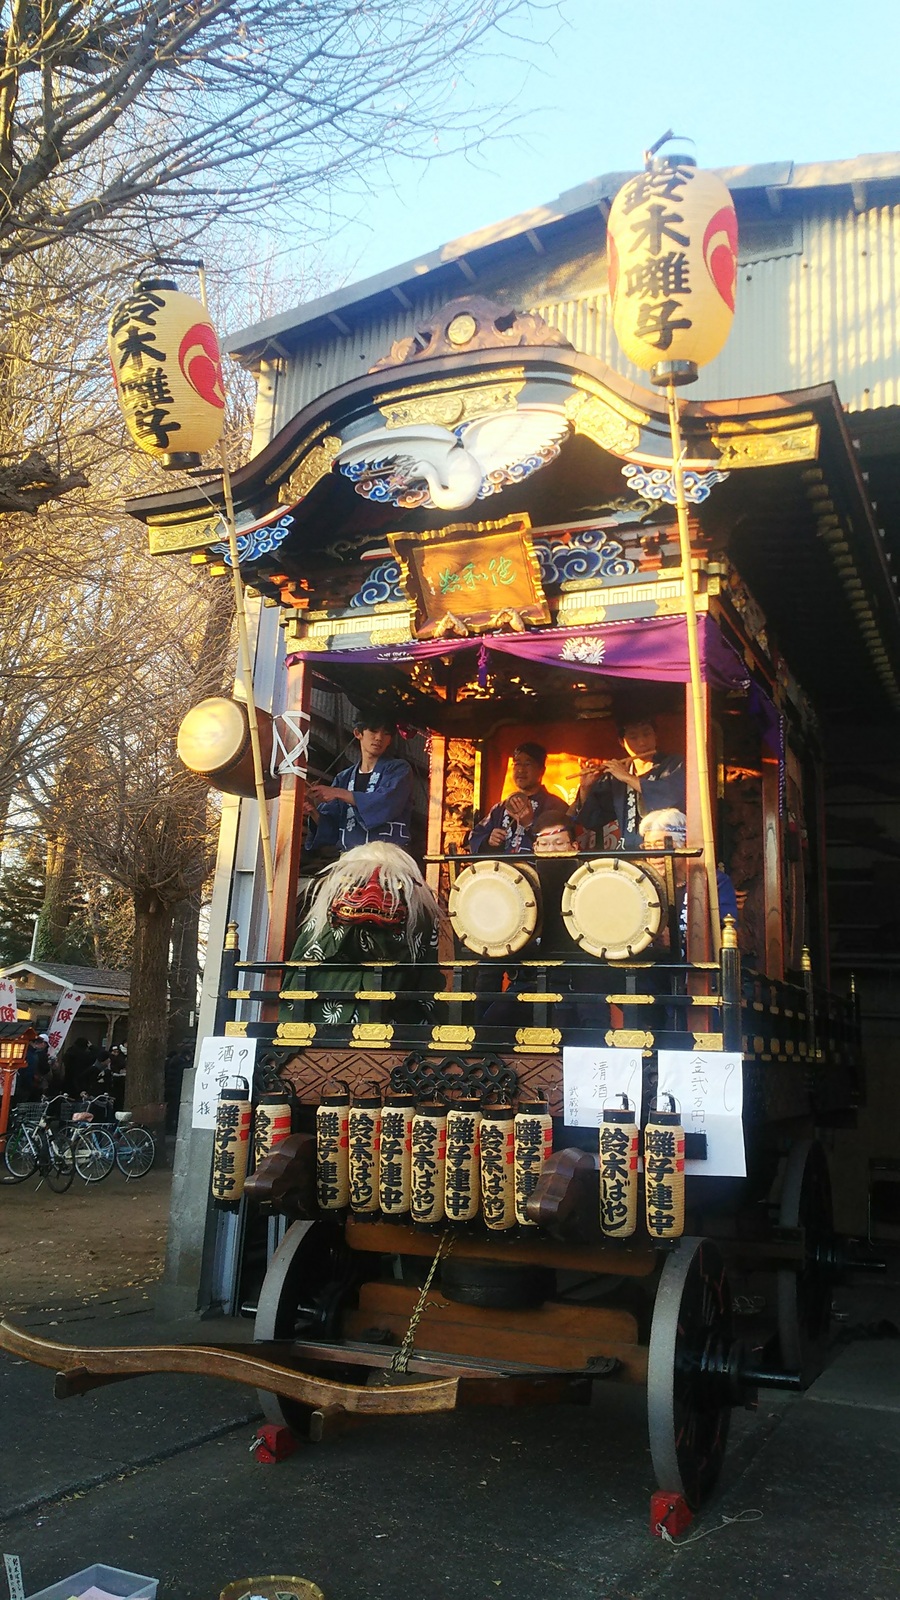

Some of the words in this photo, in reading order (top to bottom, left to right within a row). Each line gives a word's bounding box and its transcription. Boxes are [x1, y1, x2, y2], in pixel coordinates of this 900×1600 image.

[213, 1103, 240, 1196] 囃子連中
[317, 1112, 340, 1206] 囃子連中
[349, 1112, 375, 1208] 鈴木ばやし
[380, 1112, 405, 1210] 囃子連中
[411, 1120, 439, 1217] 鈴木ばやし
[446, 1116, 475, 1217] 囃子連中
[480, 1124, 507, 1223] 鈴木ばやし
[601, 1128, 630, 1232] 鈴木ばやし
[645, 1129, 675, 1235] 囃子連中
